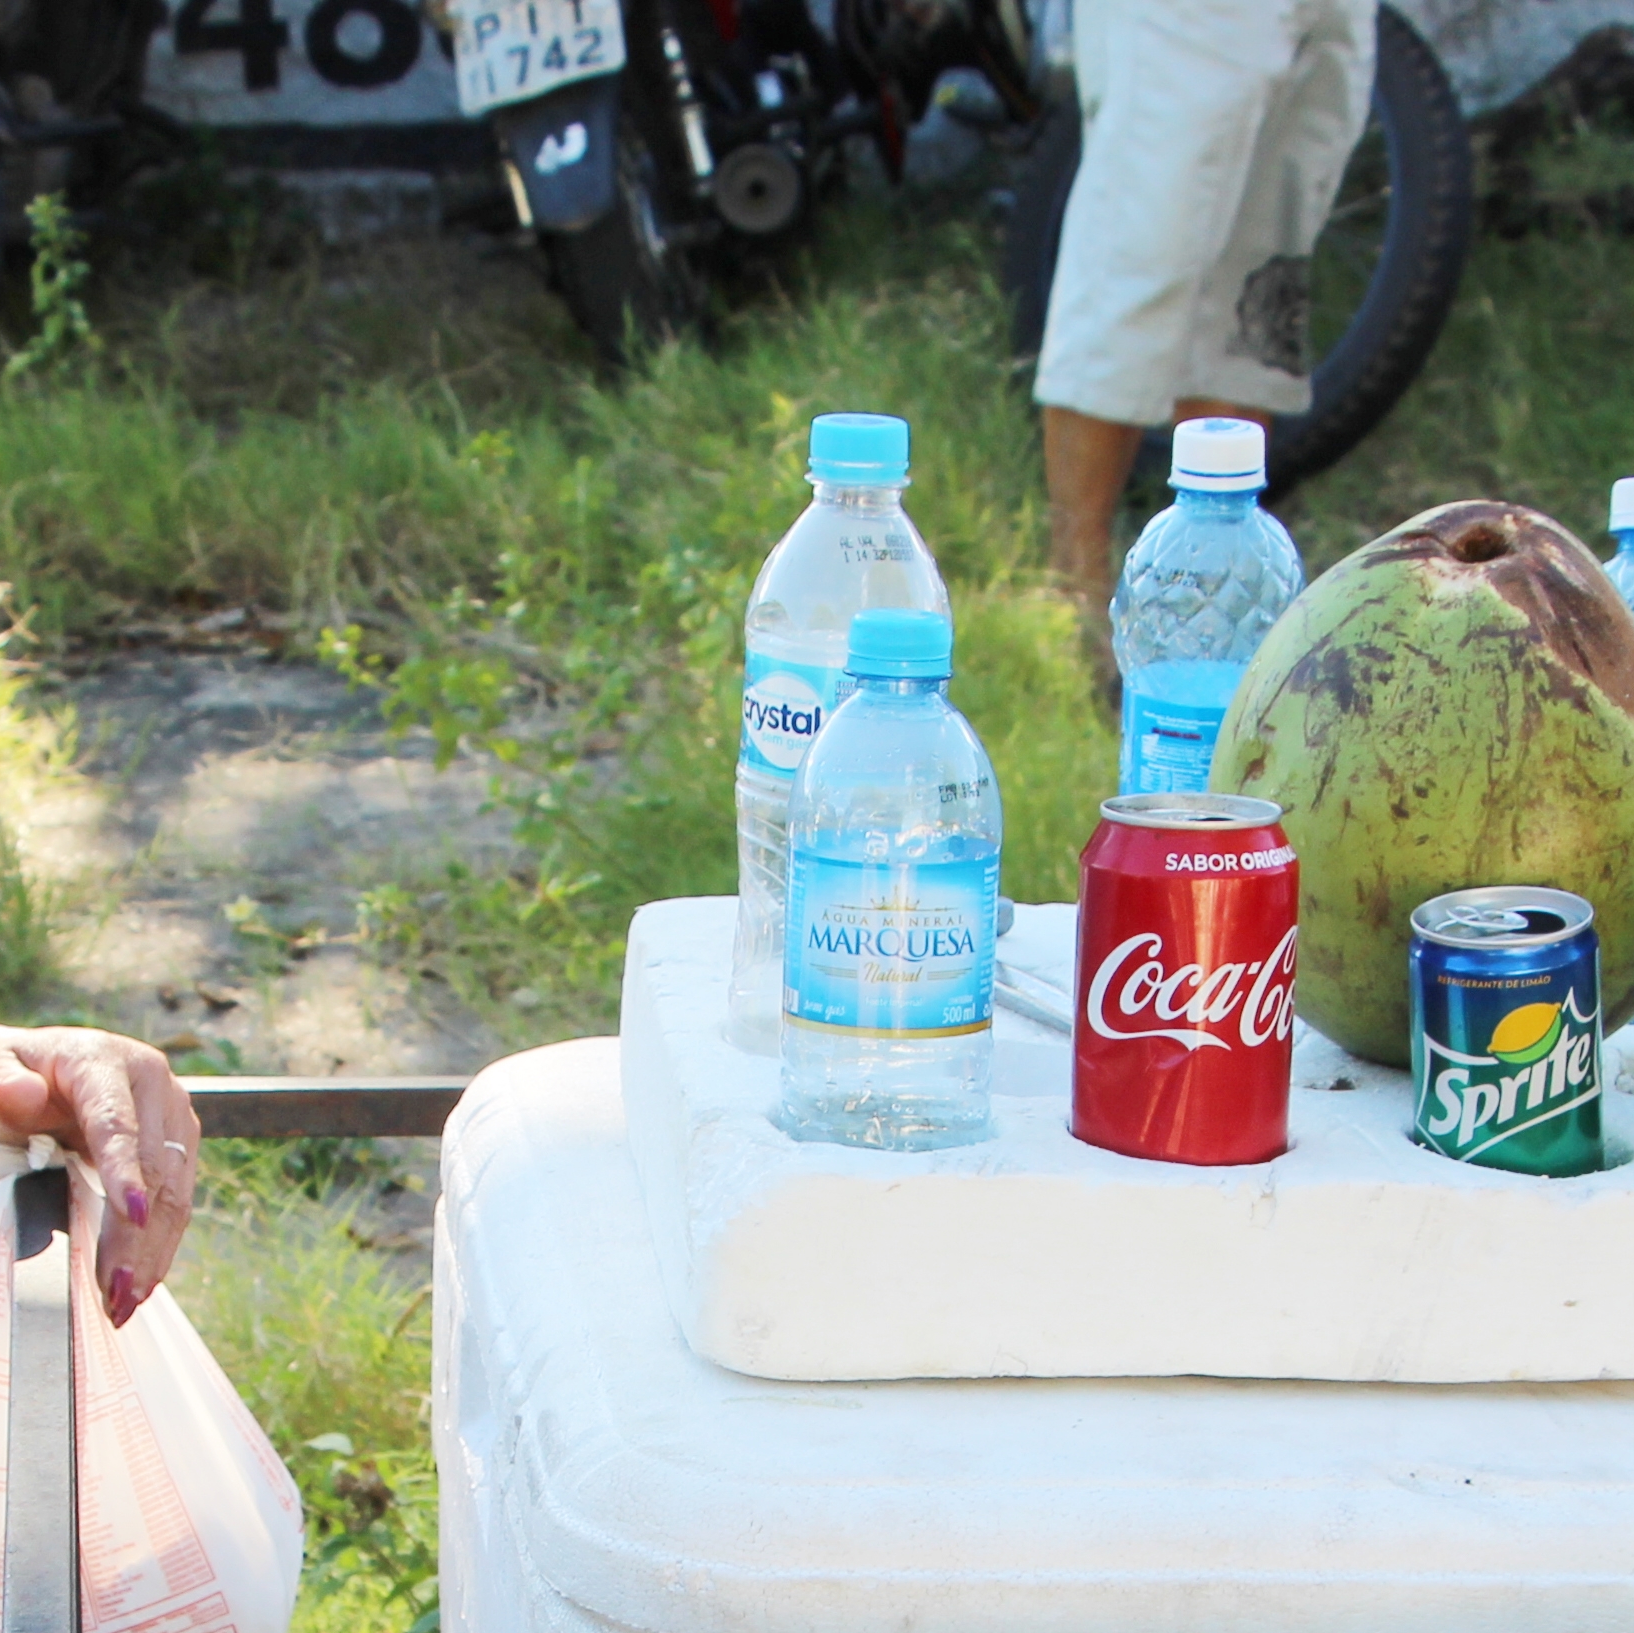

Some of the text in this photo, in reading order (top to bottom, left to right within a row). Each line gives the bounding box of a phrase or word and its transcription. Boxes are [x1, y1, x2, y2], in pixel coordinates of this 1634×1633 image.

[1165, 852, 1239, 872] SABOR
[808, 922, 976, 962] MARQUESA
[863, 961, 924, 985] Natural
[1437, 974, 1552, 989] REFRIGERANTE DE LIMÃO
[1427, 1022, 1592, 1148] Sprite
